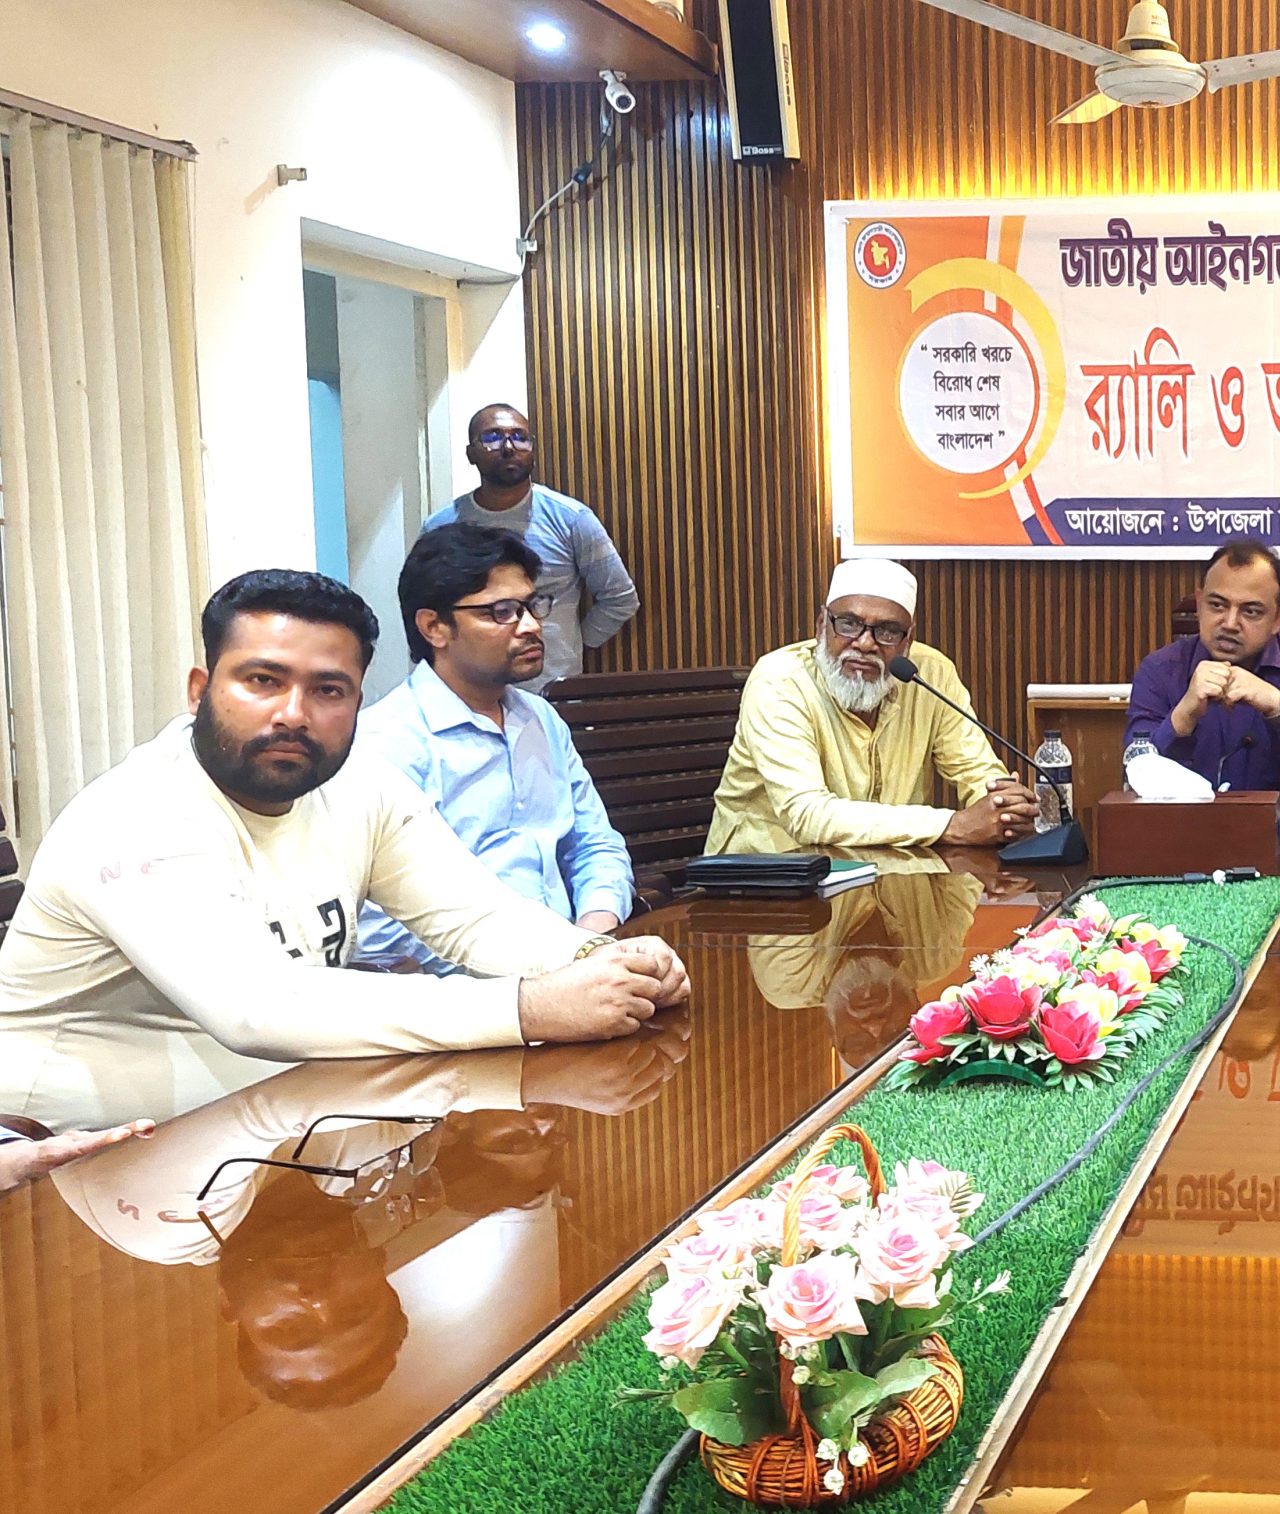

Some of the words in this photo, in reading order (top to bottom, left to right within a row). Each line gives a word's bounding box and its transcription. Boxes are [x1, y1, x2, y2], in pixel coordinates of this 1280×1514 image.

[1060, 218, 1158, 294] জাতীয়
[932, 342, 977, 363] সরকারি
[982, 346, 1012, 363] খরচে
[934, 371, 973, 392] বিরোধ
[976, 376, 1001, 392] শেষ
[935, 404, 966, 421] সবার
[968, 403, 1001, 421] আগে
[1211, 366, 1245, 449] ও
[937, 433, 993, 450] বাংলাদেশ
[1065, 508, 1165, 535] আয়োজনে
[1186, 502, 1274, 535] উপজেলা
